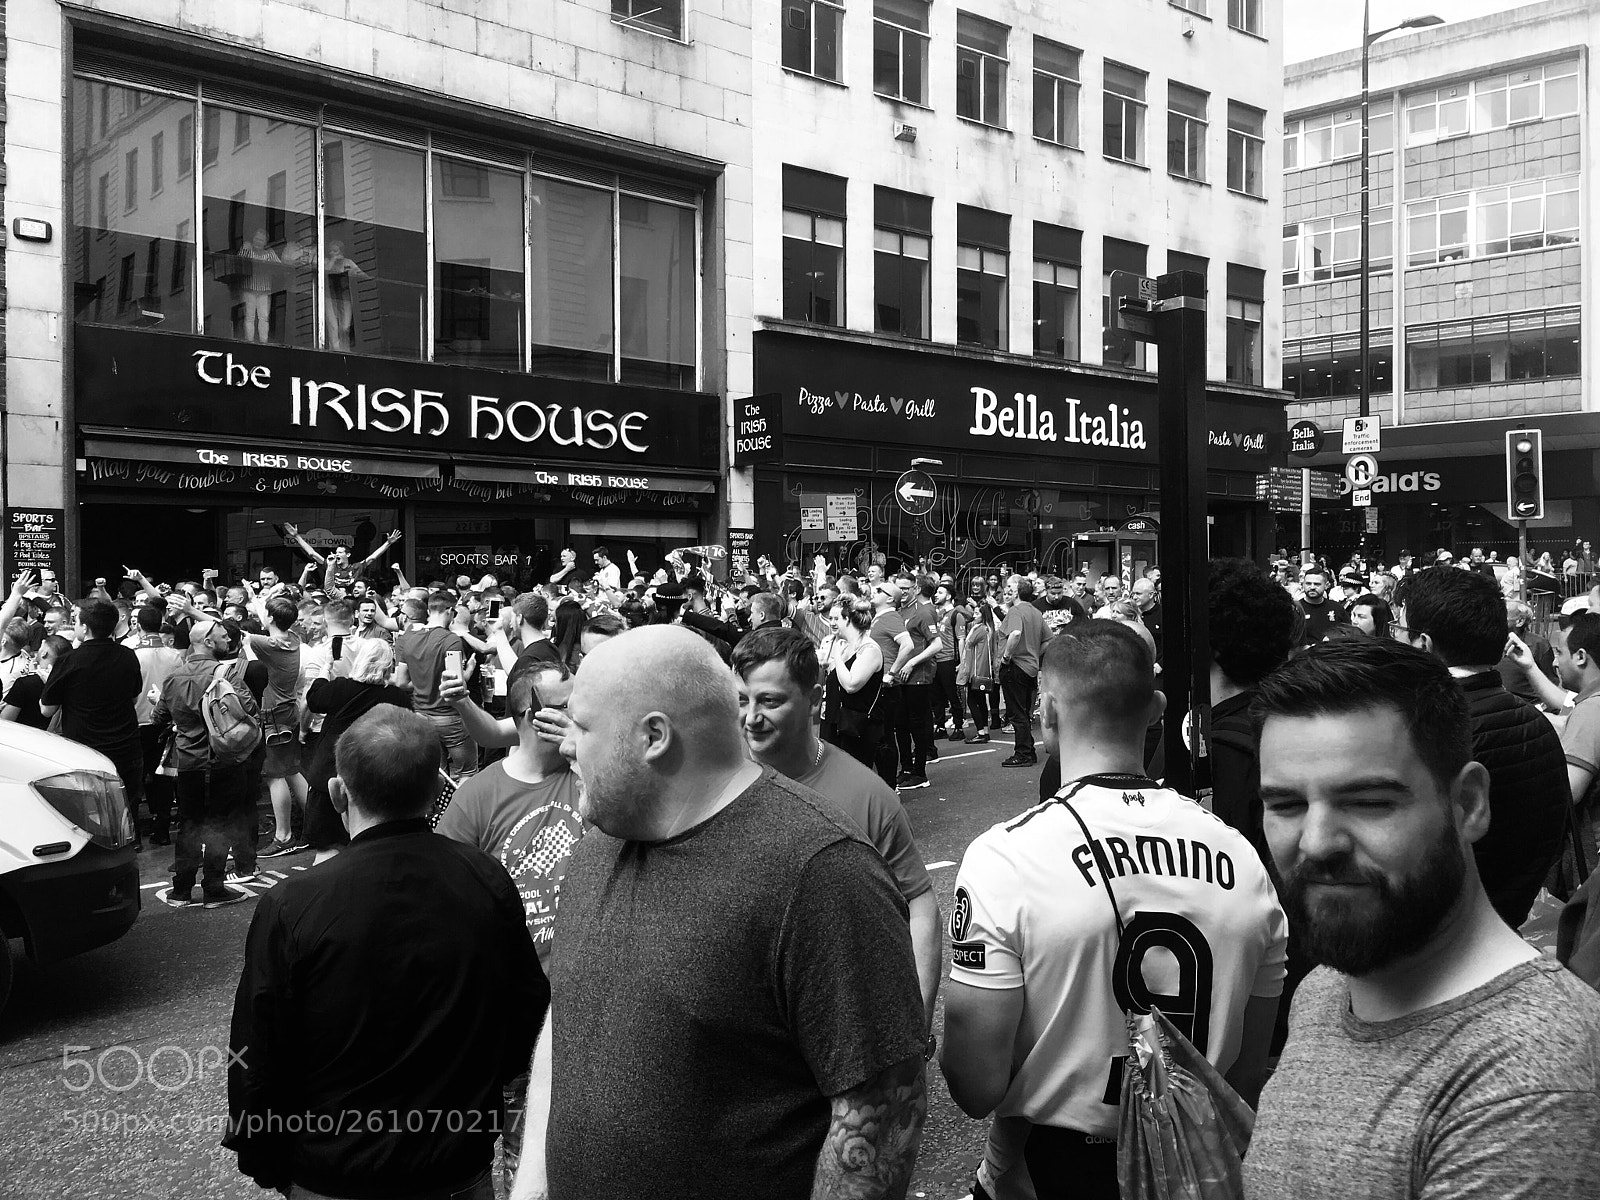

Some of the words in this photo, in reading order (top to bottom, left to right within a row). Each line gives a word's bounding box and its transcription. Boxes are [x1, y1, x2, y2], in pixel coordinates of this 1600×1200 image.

[192, 350, 272, 389] The
[744, 403, 760, 416] The
[798, 387, 834, 415] Pizza
[853, 392, 889, 413] Pasta
[905, 398, 936, 420] Grill
[290, 376, 450, 437] IRISH
[468, 394, 650, 453] HOUSE
[969, 386, 1057, 442] Bella
[1064, 398, 1147, 451] Italia
[740, 418, 767, 435] IRISH
[1291, 426, 1315, 440] Bella
[736, 434, 772, 453] HOUSE
[1208, 430, 1233, 446] Pasta
[1243, 433, 1265, 452] Grill
[1291, 440, 1315, 452] Italia
[1344, 438, 1379, 446] enforcement
[196, 450, 229, 465] The
[242, 452, 288, 469] IRISH
[297, 457, 353, 473] HOUSE
[91, 459, 130, 481] May
[137, 461, 175, 485] your
[178, 466, 235, 489] troubles
[535, 471, 559, 485] The
[568, 473, 603, 488] IRISH
[608, 475, 649, 490] HOUSE
[1354, 493, 1370, 502] End
[12, 512, 54, 524] SPORTS
[1127, 521, 1146, 530] cash
[20, 541, 32, 549] Big
[32, 541, 56, 549] Screens
[440, 553, 489, 566] SPORTS
[494, 554, 518, 566] BAR
[1102, 911, 1214, 1105] 9
